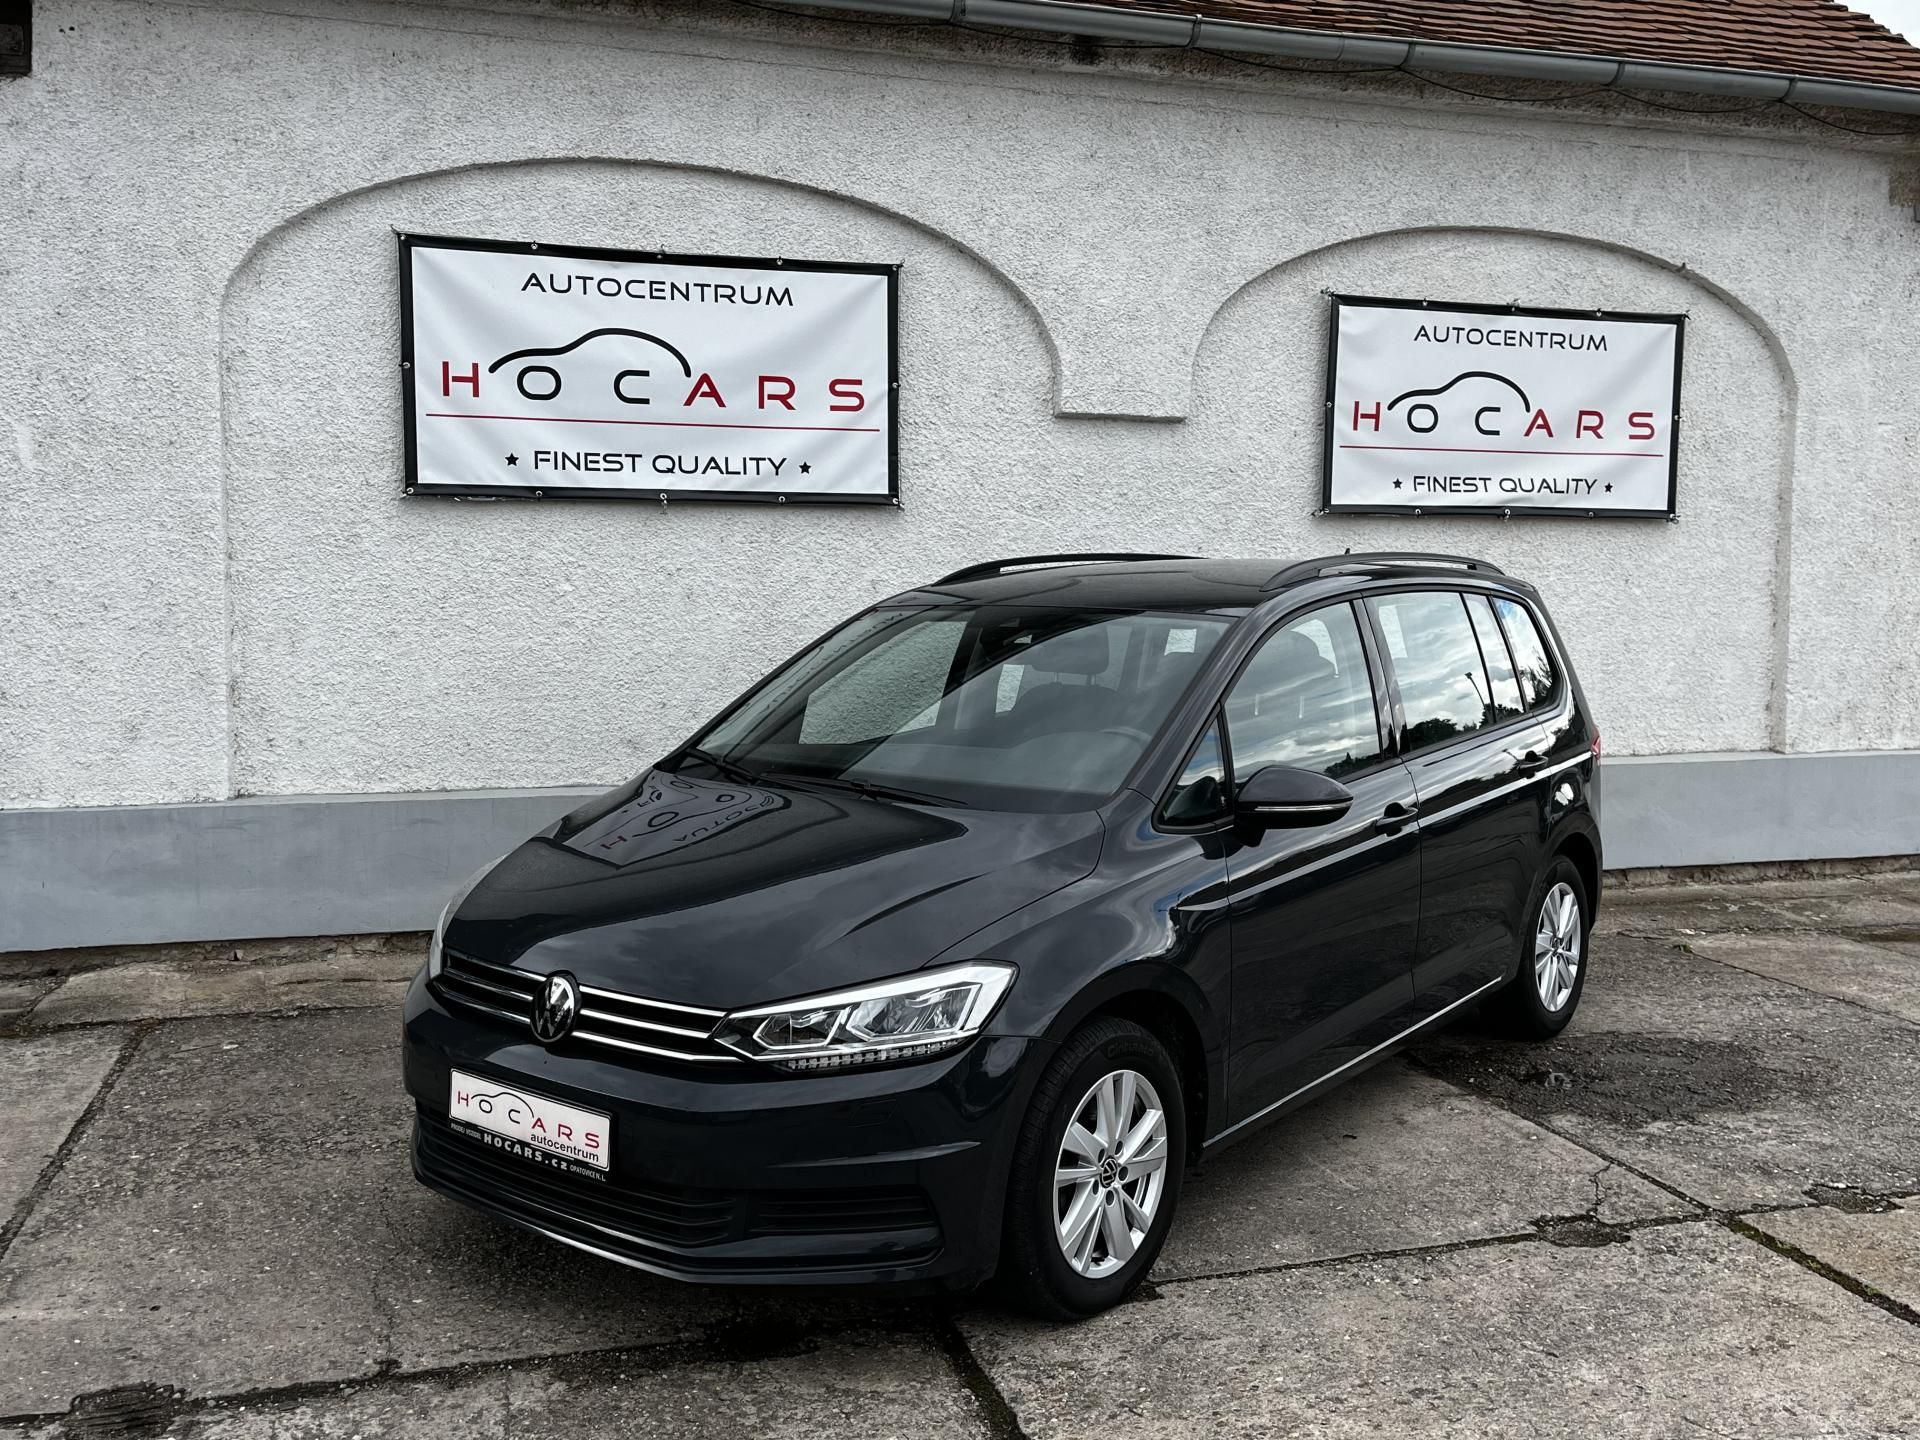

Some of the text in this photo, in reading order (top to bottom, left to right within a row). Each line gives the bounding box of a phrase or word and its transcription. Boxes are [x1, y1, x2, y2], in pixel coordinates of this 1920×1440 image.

[521, 272, 794, 307] AUTOCENTRUM
[1413, 325, 1608, 352] AUTOCENTRUM
[534, 450, 788, 477] FINEST QUALITY
[1413, 475, 1598, 495] FINEST QUALITY
[530, 1133, 599, 1163] autocentrum
